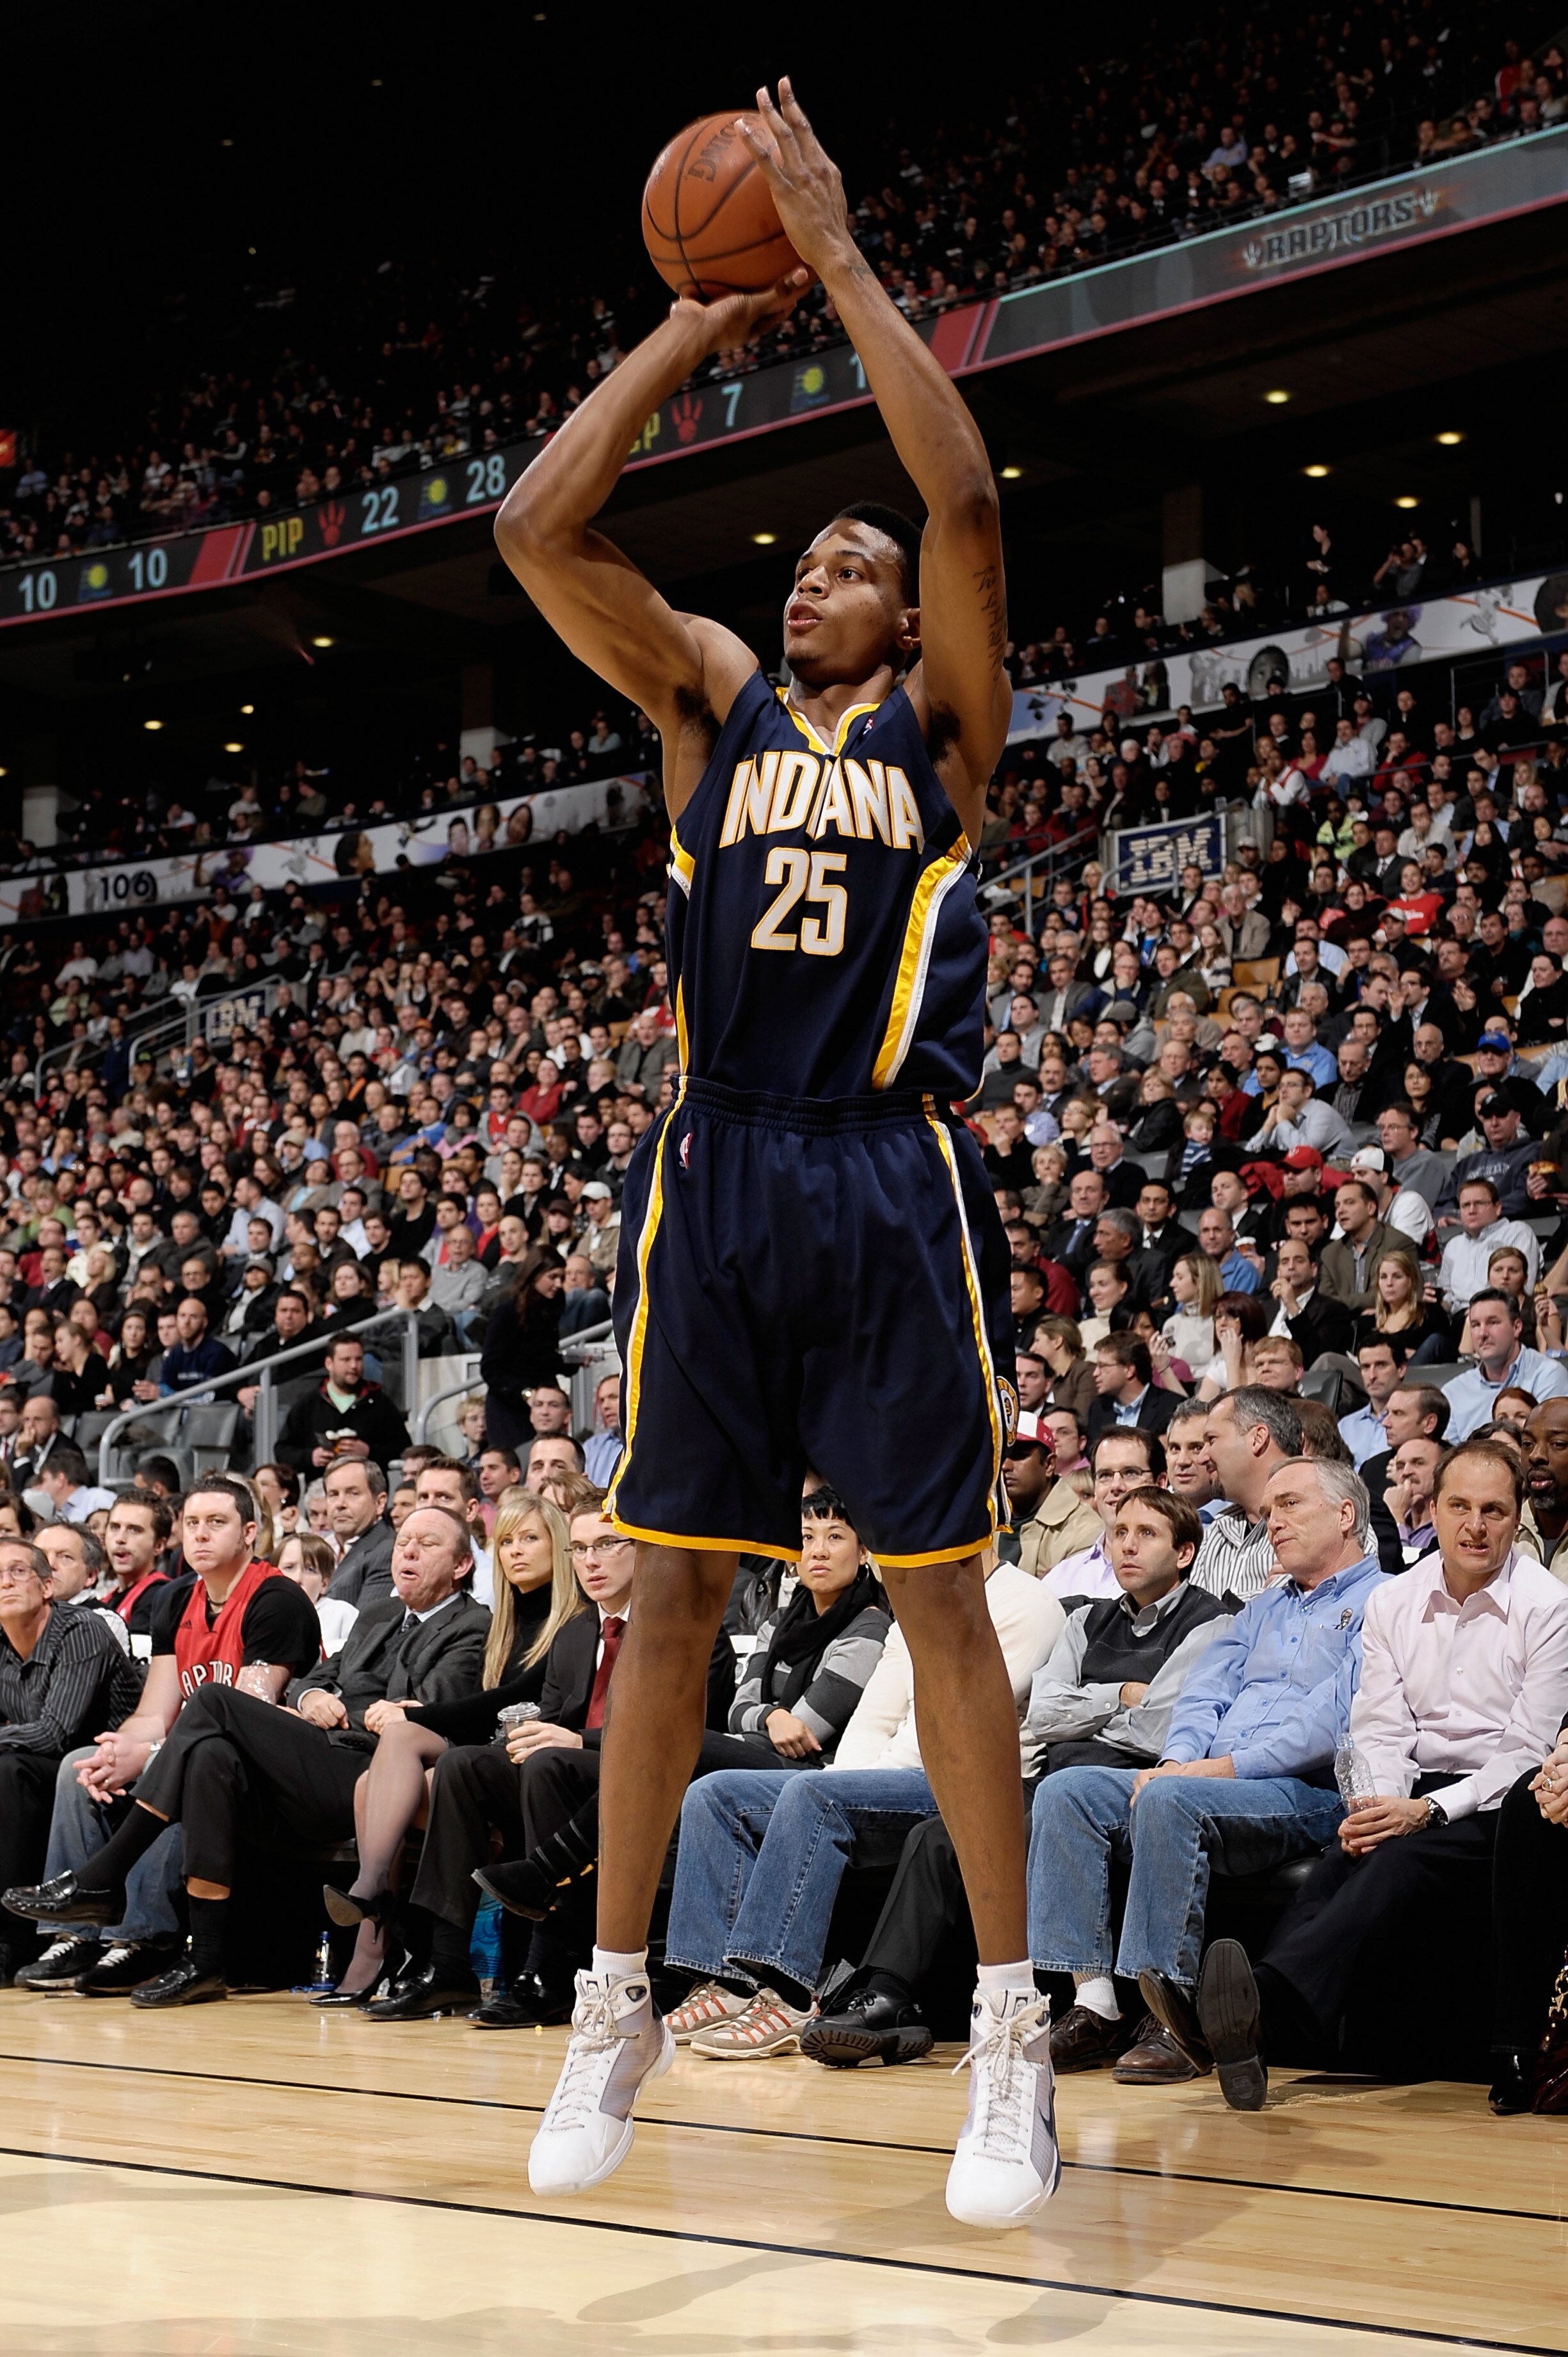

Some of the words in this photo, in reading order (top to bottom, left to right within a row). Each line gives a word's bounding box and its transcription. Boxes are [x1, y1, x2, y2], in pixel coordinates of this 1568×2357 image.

[1260, 193, 1418, 268] RAPTORS
[721, 382, 743, 428] 7
[262, 516, 303, 562] PIP
[361, 486, 400, 534] 22
[467, 454, 506, 503] 28
[19, 570, 57, 612] 10
[129, 548, 168, 589] 10
[718, 751, 924, 854] INDIANA
[101, 871, 149, 901] 106
[1129, 827, 1212, 883] IBM
[751, 847, 847, 956] 25
